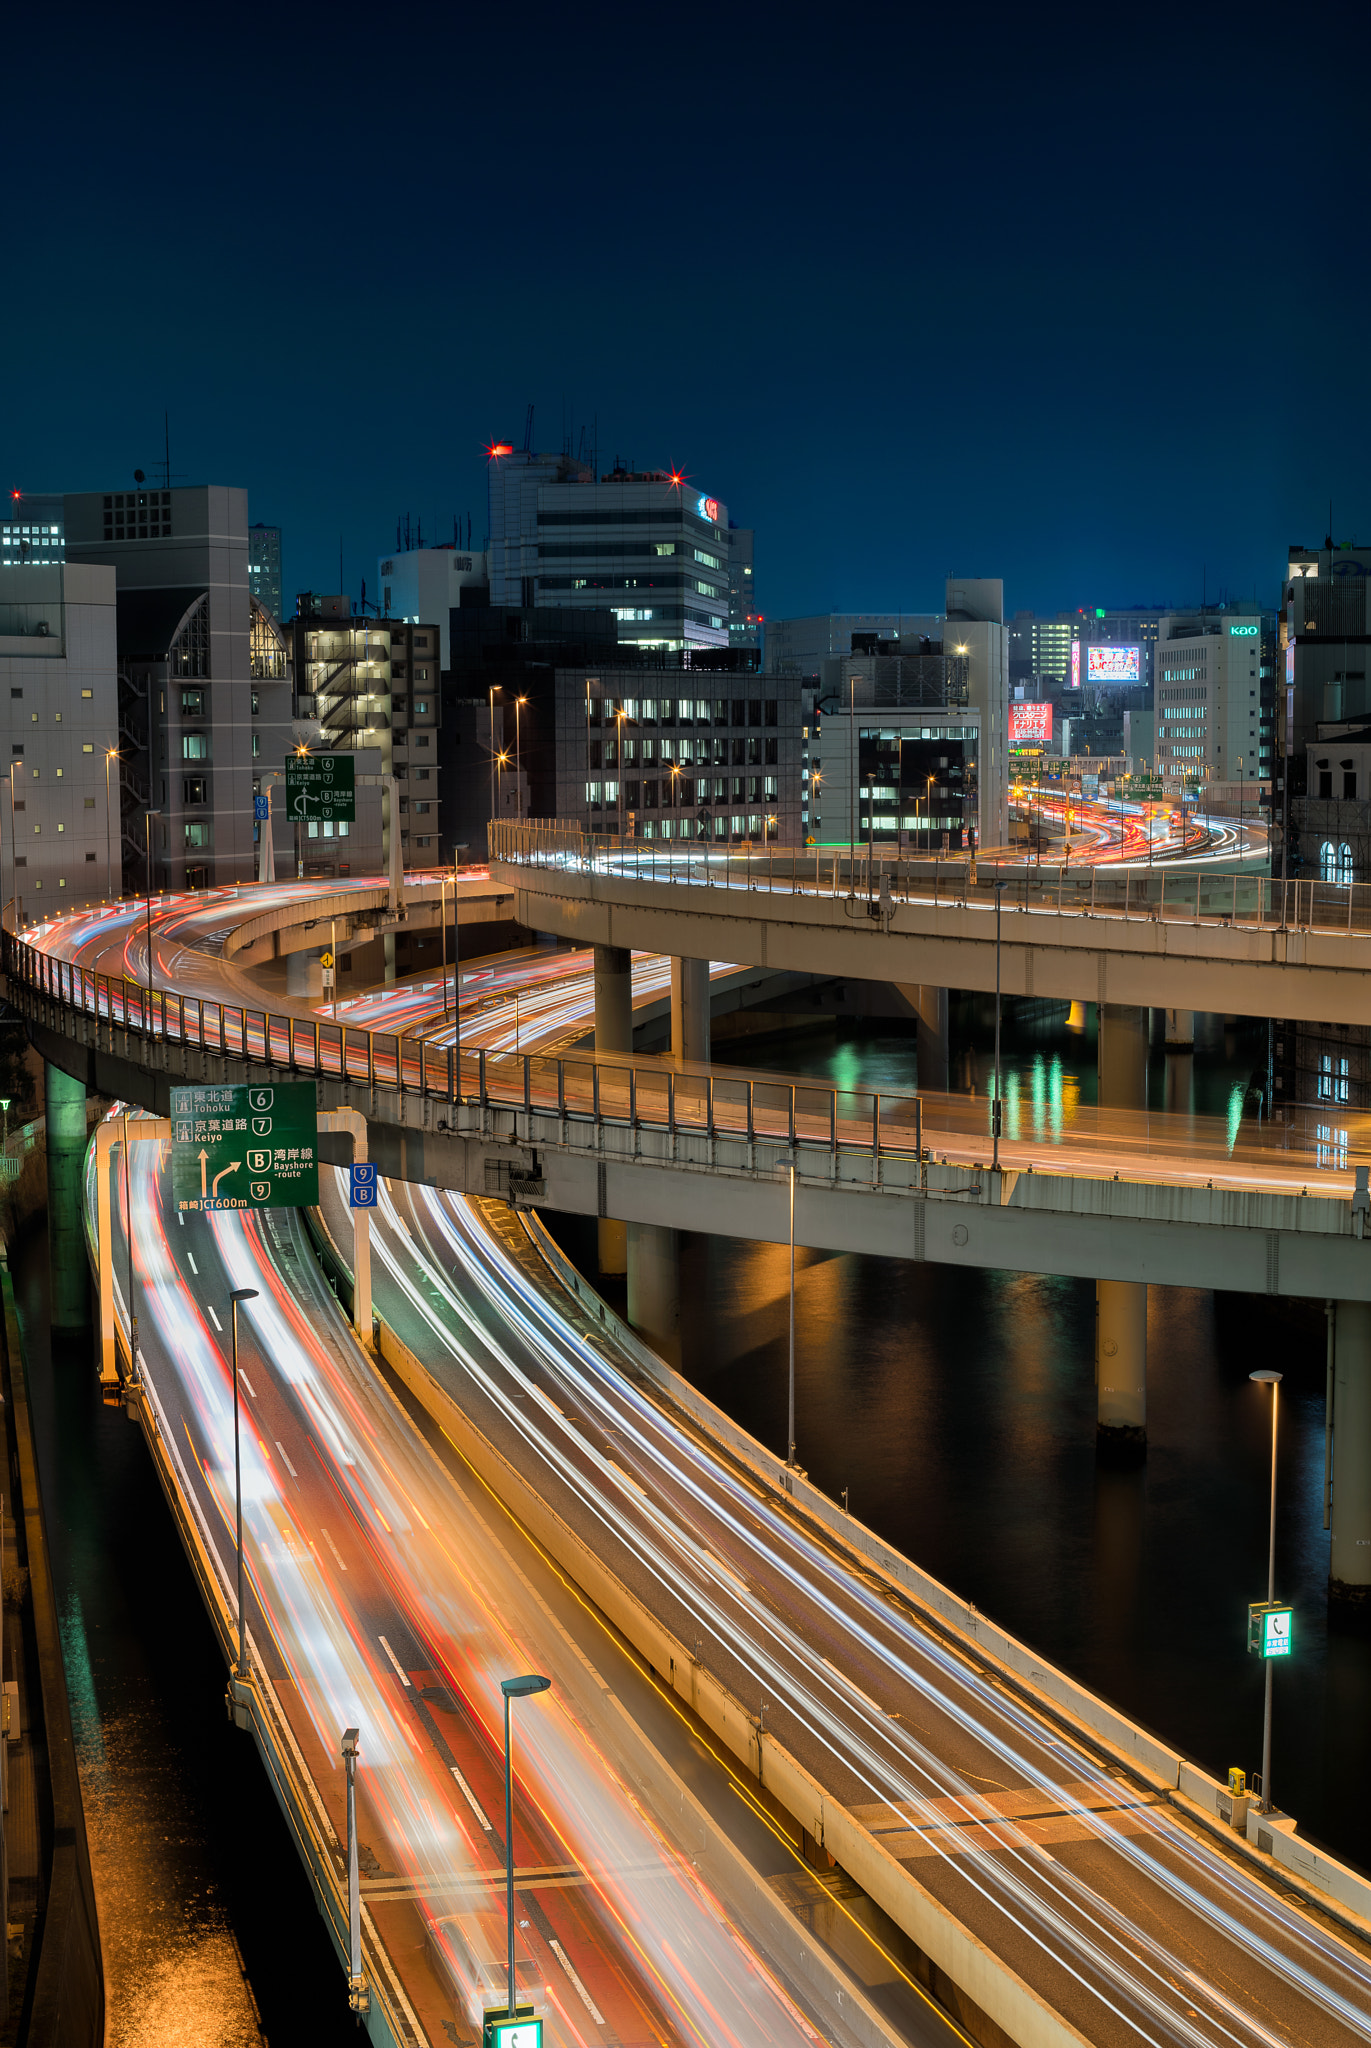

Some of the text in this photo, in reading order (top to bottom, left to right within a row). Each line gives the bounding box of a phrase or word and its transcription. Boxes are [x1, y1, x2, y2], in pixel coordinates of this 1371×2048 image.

[1014, 720, 1046, 729] ドナリエラ
[325, 760, 331, 768] 6
[324, 792, 330, 801] B
[194, 1089, 234, 1103] 東北道
[256, 1092, 266, 1106] 6
[194, 1104, 231, 1113] Tohoku
[194, 1118, 248, 1132] 京葉道路
[258, 1120, 266, 1132] 7
[194, 1133, 223, 1144] Keiyo
[273, 1147, 314, 1161] 湾岸線
[254, 1153, 265, 1168] B
[273, 1161, 314, 1172] Bayshore
[273, 1170, 302, 1178] -route
[360, 1168, 367, 1180] 9
[256, 1184, 265, 1197] 9
[360, 1189, 368, 1201] B
